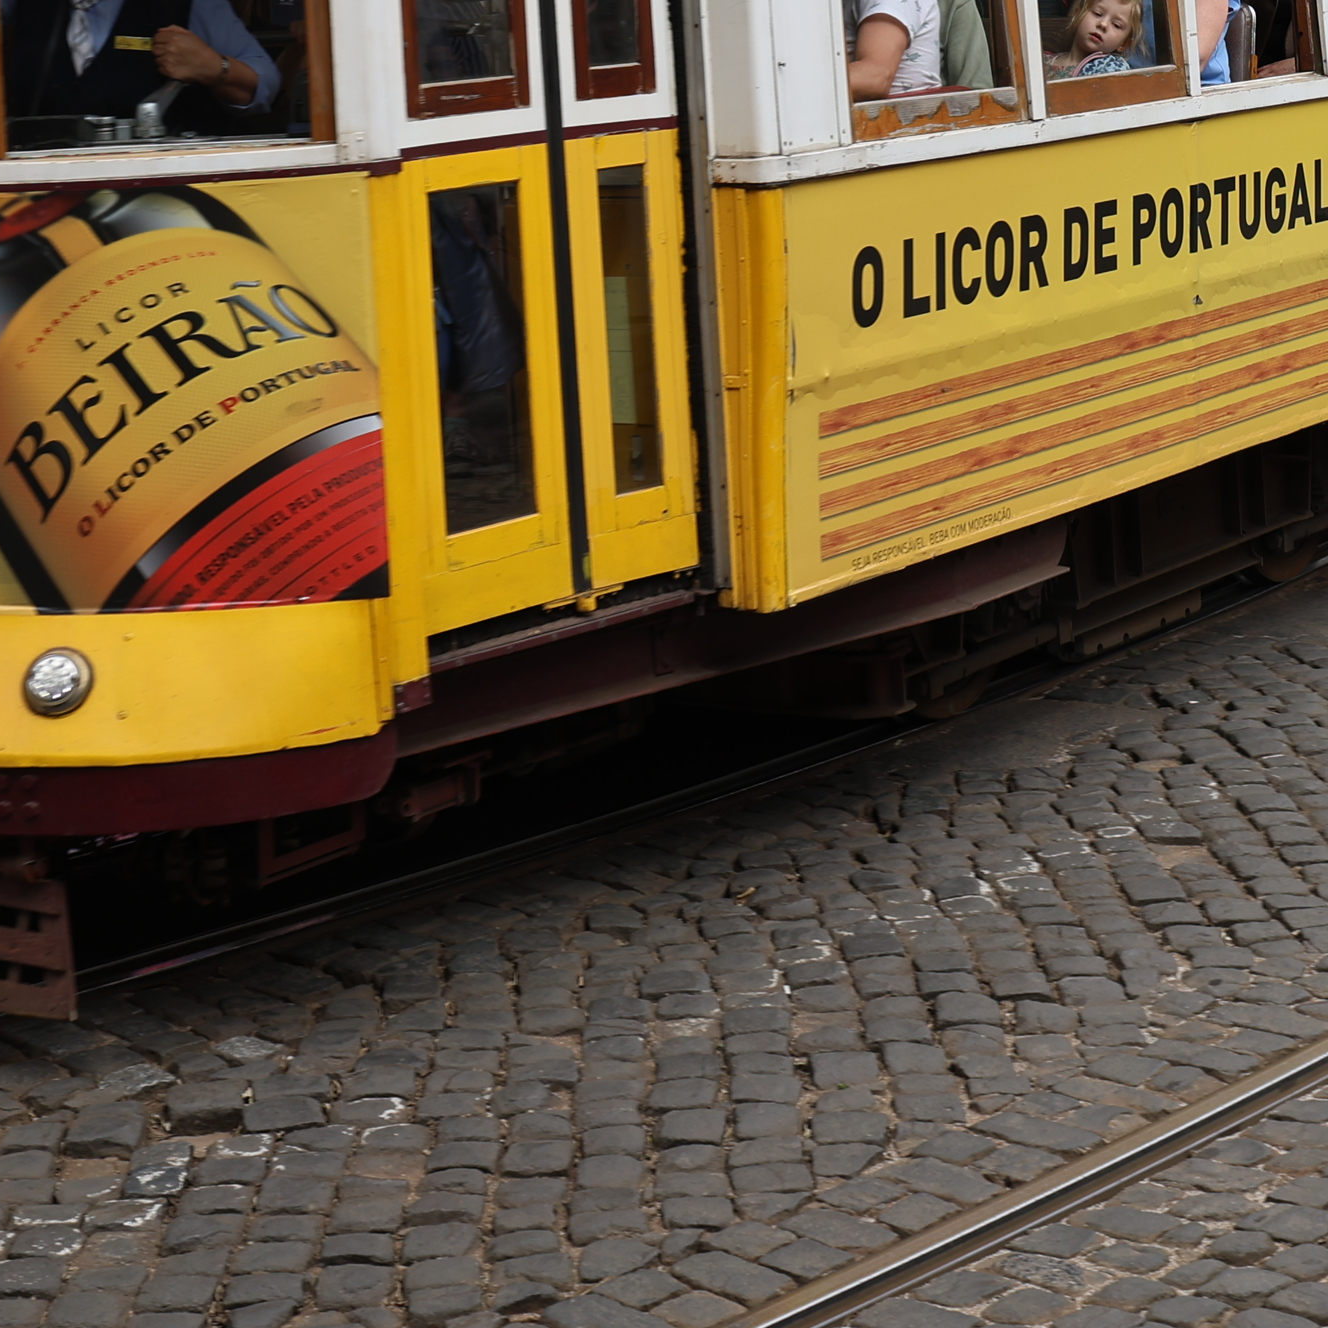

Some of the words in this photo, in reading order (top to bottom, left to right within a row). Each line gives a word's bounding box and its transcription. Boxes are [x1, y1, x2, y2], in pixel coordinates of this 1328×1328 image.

[75, 281, 190, 352] LICOR
[852, 245, 884, 329] O
[902, 213, 1049, 319] LICOR
[1063, 198, 1118, 283] DE
[5, 279, 339, 523] BEIRÃO
[76, 514, 97, 539] O
[91, 441, 174, 518] LICOR
[172, 409, 218, 446] DE
[216, 358, 362, 417] PORTUGAL
[851, 556, 871, 571] SEJA
[929, 529, 949, 545] BEBA
[950, 523, 967, 538] COM
[967, 506, 1012, 531] MODERAÇÃO
